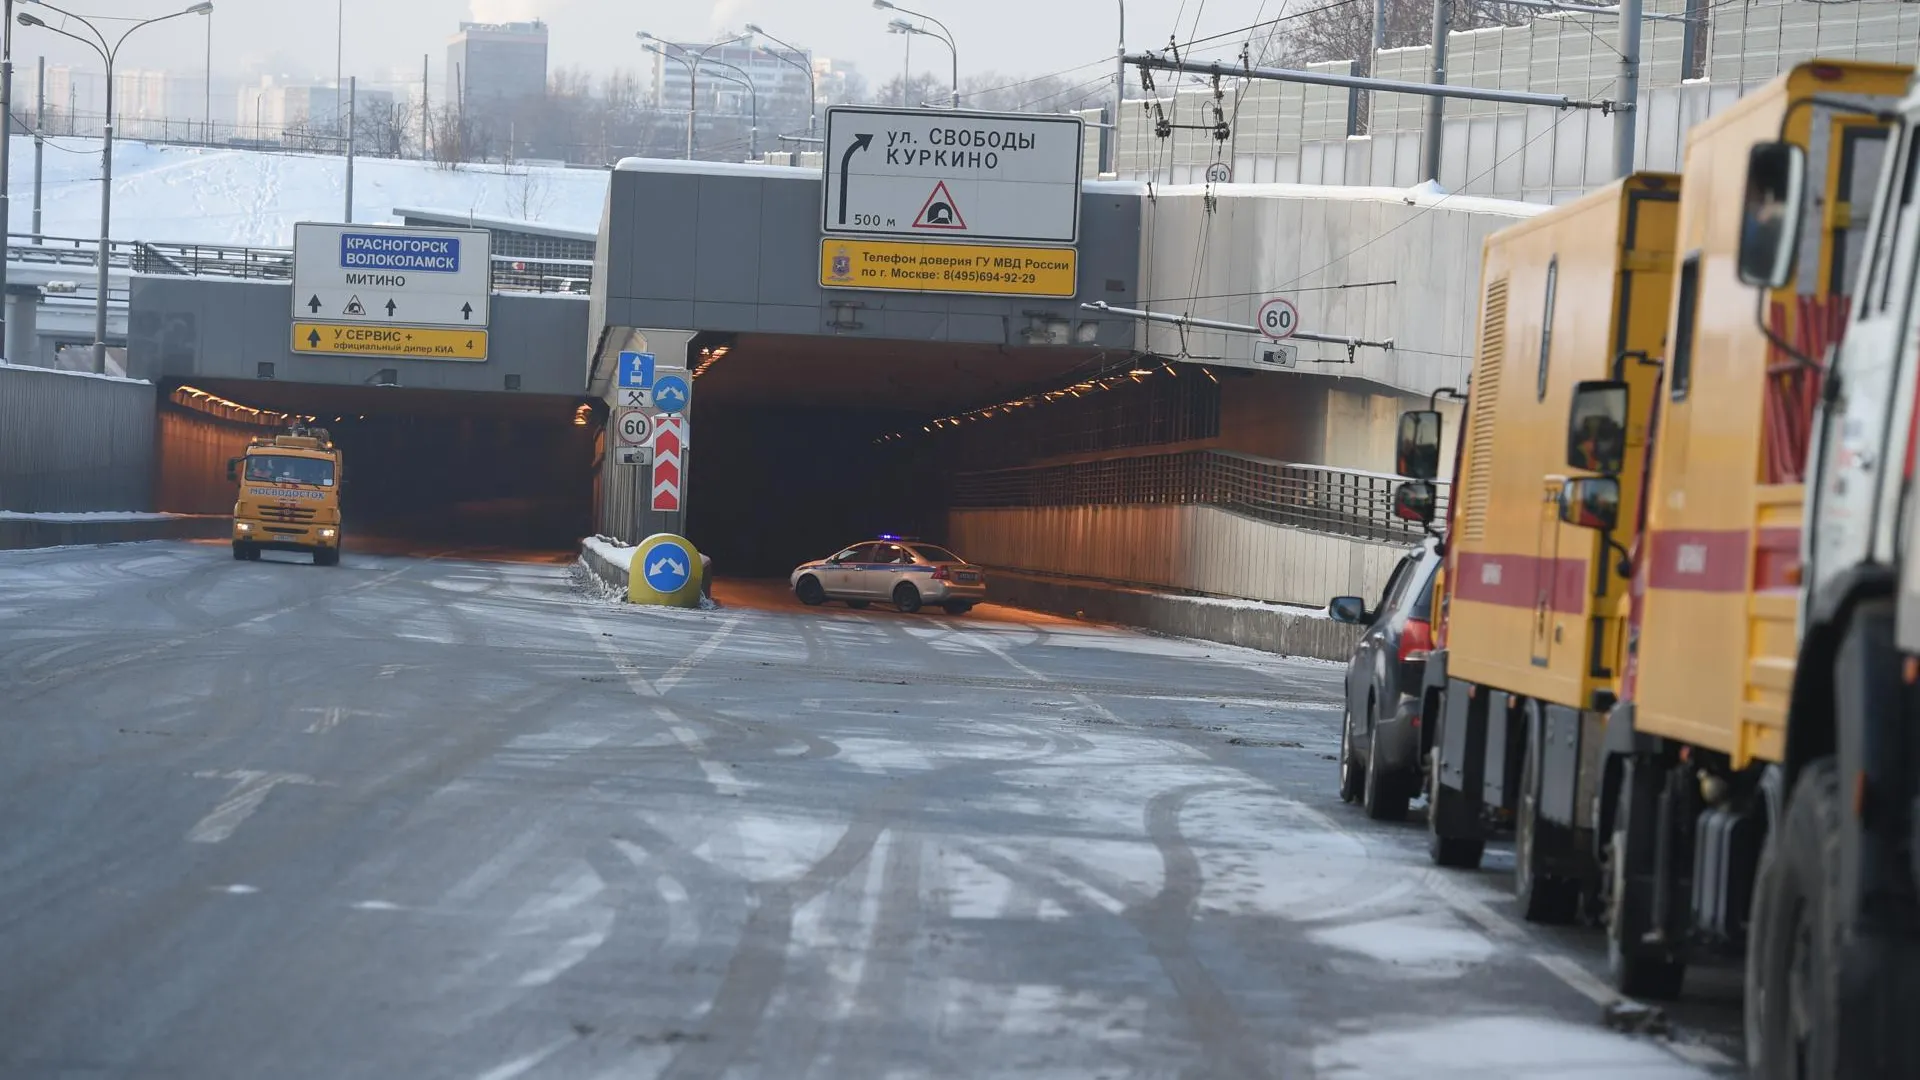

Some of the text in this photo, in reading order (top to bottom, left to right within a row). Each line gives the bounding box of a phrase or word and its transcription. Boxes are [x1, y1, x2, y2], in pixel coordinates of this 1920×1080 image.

[887, 128, 1035, 150] ул. СВОБОДЫ
[886, 149, 998, 169] КУРКИНО
[1210, 170, 1226, 182] 50
[854, 214, 896, 227] 500 м
[346, 238, 448, 254] КРАСНОГОРСК
[346, 253, 455, 269] ВОЛОКОЛАМСК
[862, 252, 1069, 271] Телефон доверия ГУ МВД России
[346, 273, 406, 287] МИТИНО
[861, 268, 1036, 284] по г. Москве: 8(495)694-92-29
[1266, 310, 1290, 328] 60
[334, 329, 343, 340] У
[346, 329, 402, 342] СЕРВИС
[333, 342, 402, 352] официальный
[435, 345, 454, 354] КИА
[465, 340, 473, 350] 4
[625, 420, 645, 435] 60
